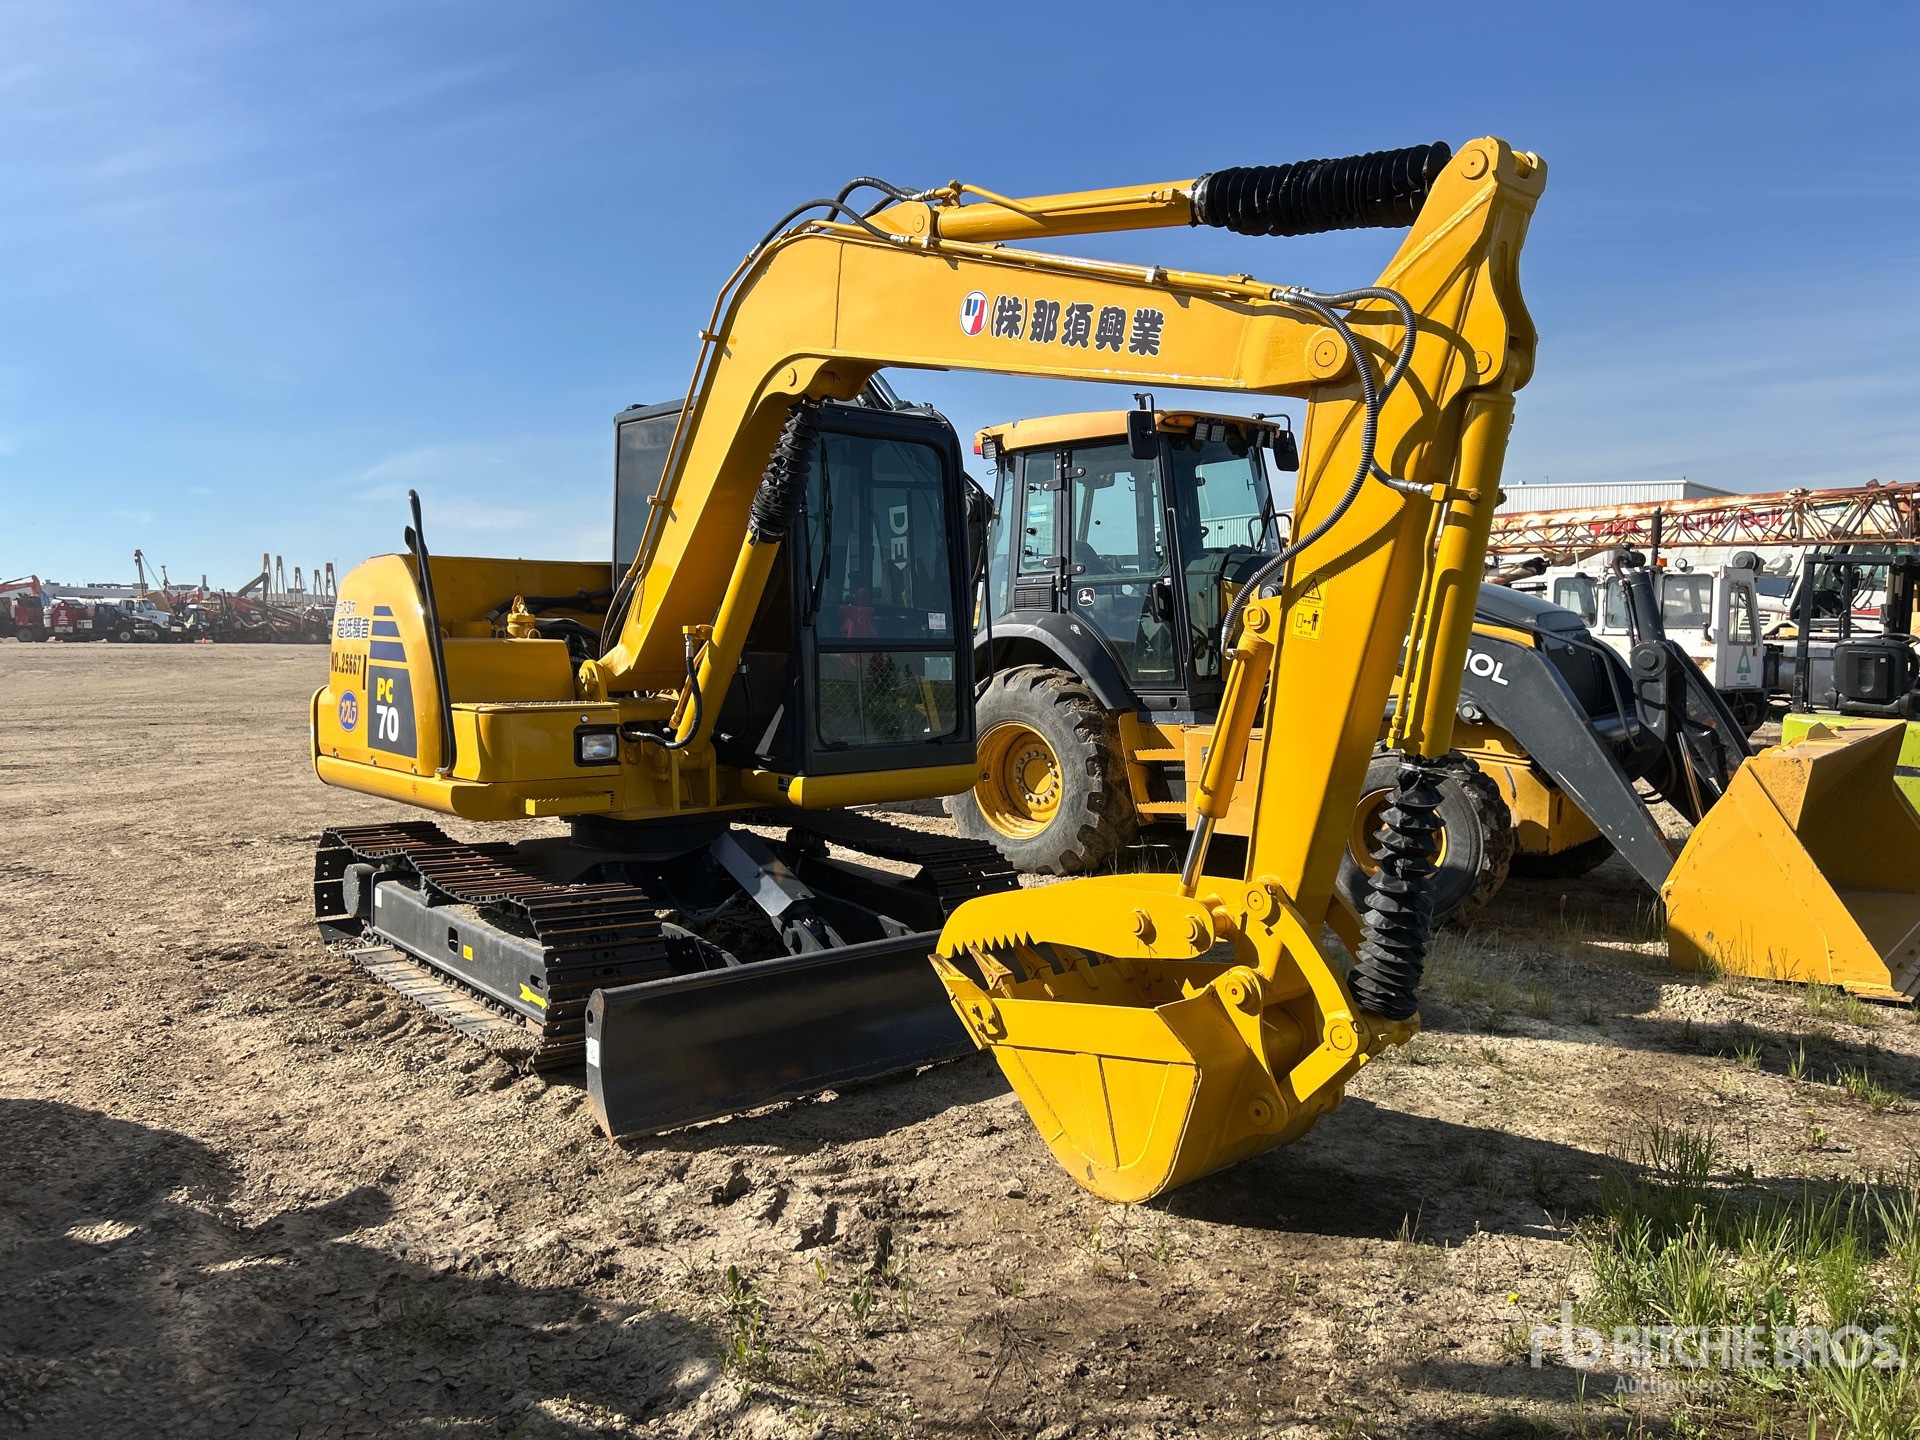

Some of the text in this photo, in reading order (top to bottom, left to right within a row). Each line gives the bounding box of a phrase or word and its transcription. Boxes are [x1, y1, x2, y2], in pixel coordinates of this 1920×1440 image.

[331, 652, 361, 675] NO.25667
[376, 677, 394, 704] PC
[376, 704, 400, 742] 70
